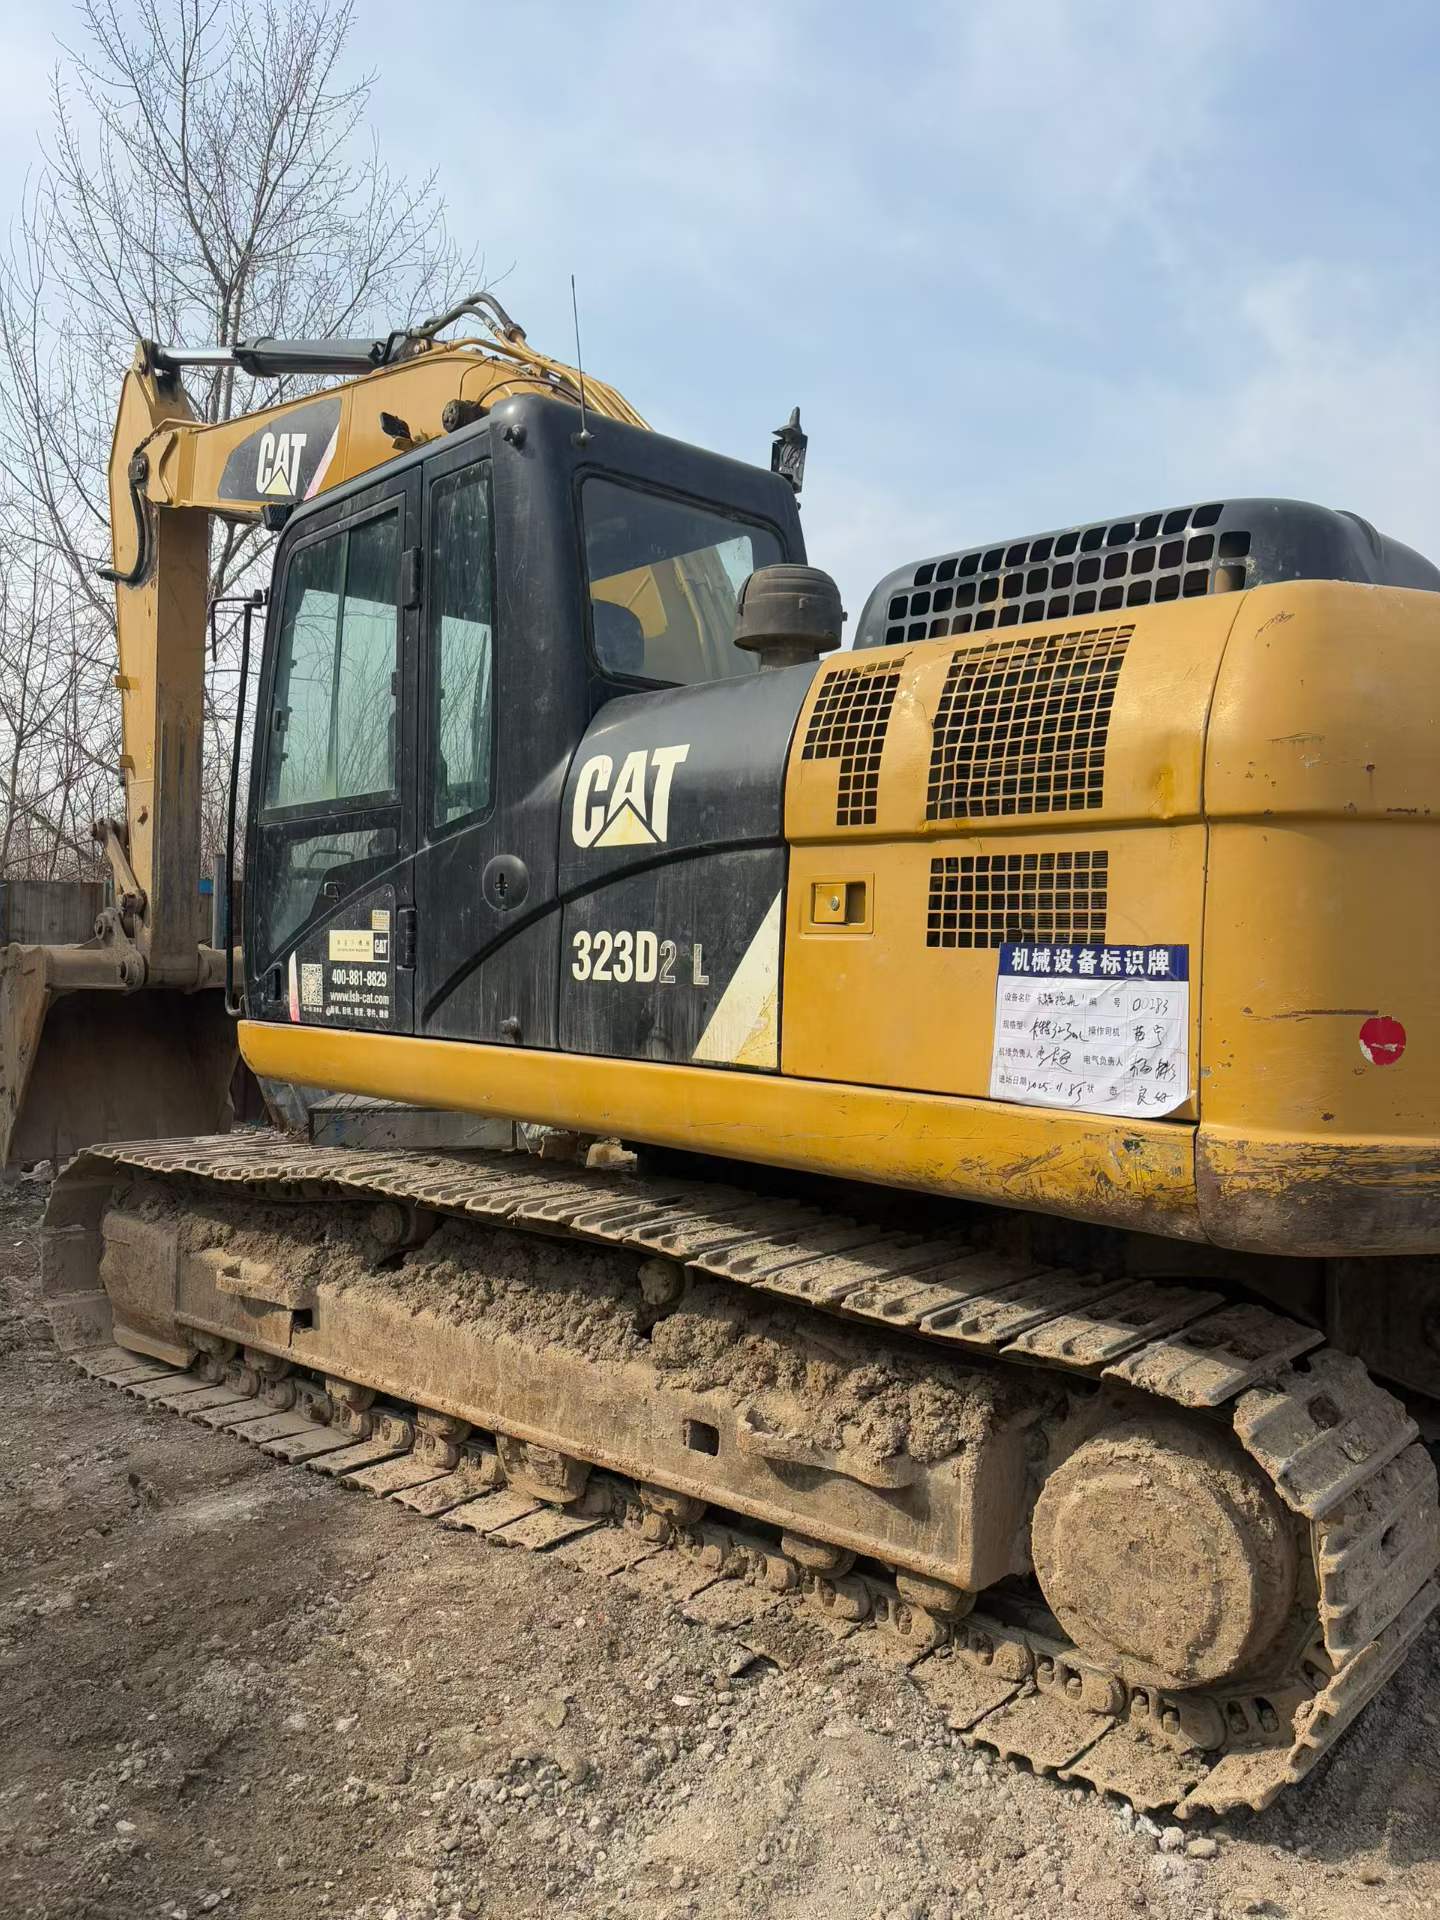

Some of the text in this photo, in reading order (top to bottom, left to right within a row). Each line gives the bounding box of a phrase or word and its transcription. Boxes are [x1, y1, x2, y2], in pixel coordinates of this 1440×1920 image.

[256, 432, 307, 496] CAT
[572, 743, 690, 848] CAT
[374, 939, 388, 954] CAT
[693, 943, 709, 985] L
[1011, 947, 1170, 976] 机械设备标识牌
[332, 969, 387, 987] 400-881-8829
[1002, 1019, 1028, 1031] 规格型
[1088, 1025, 1121, 1037] 操作司机
[1083, 1055, 1123, 1067] 电气负责人
